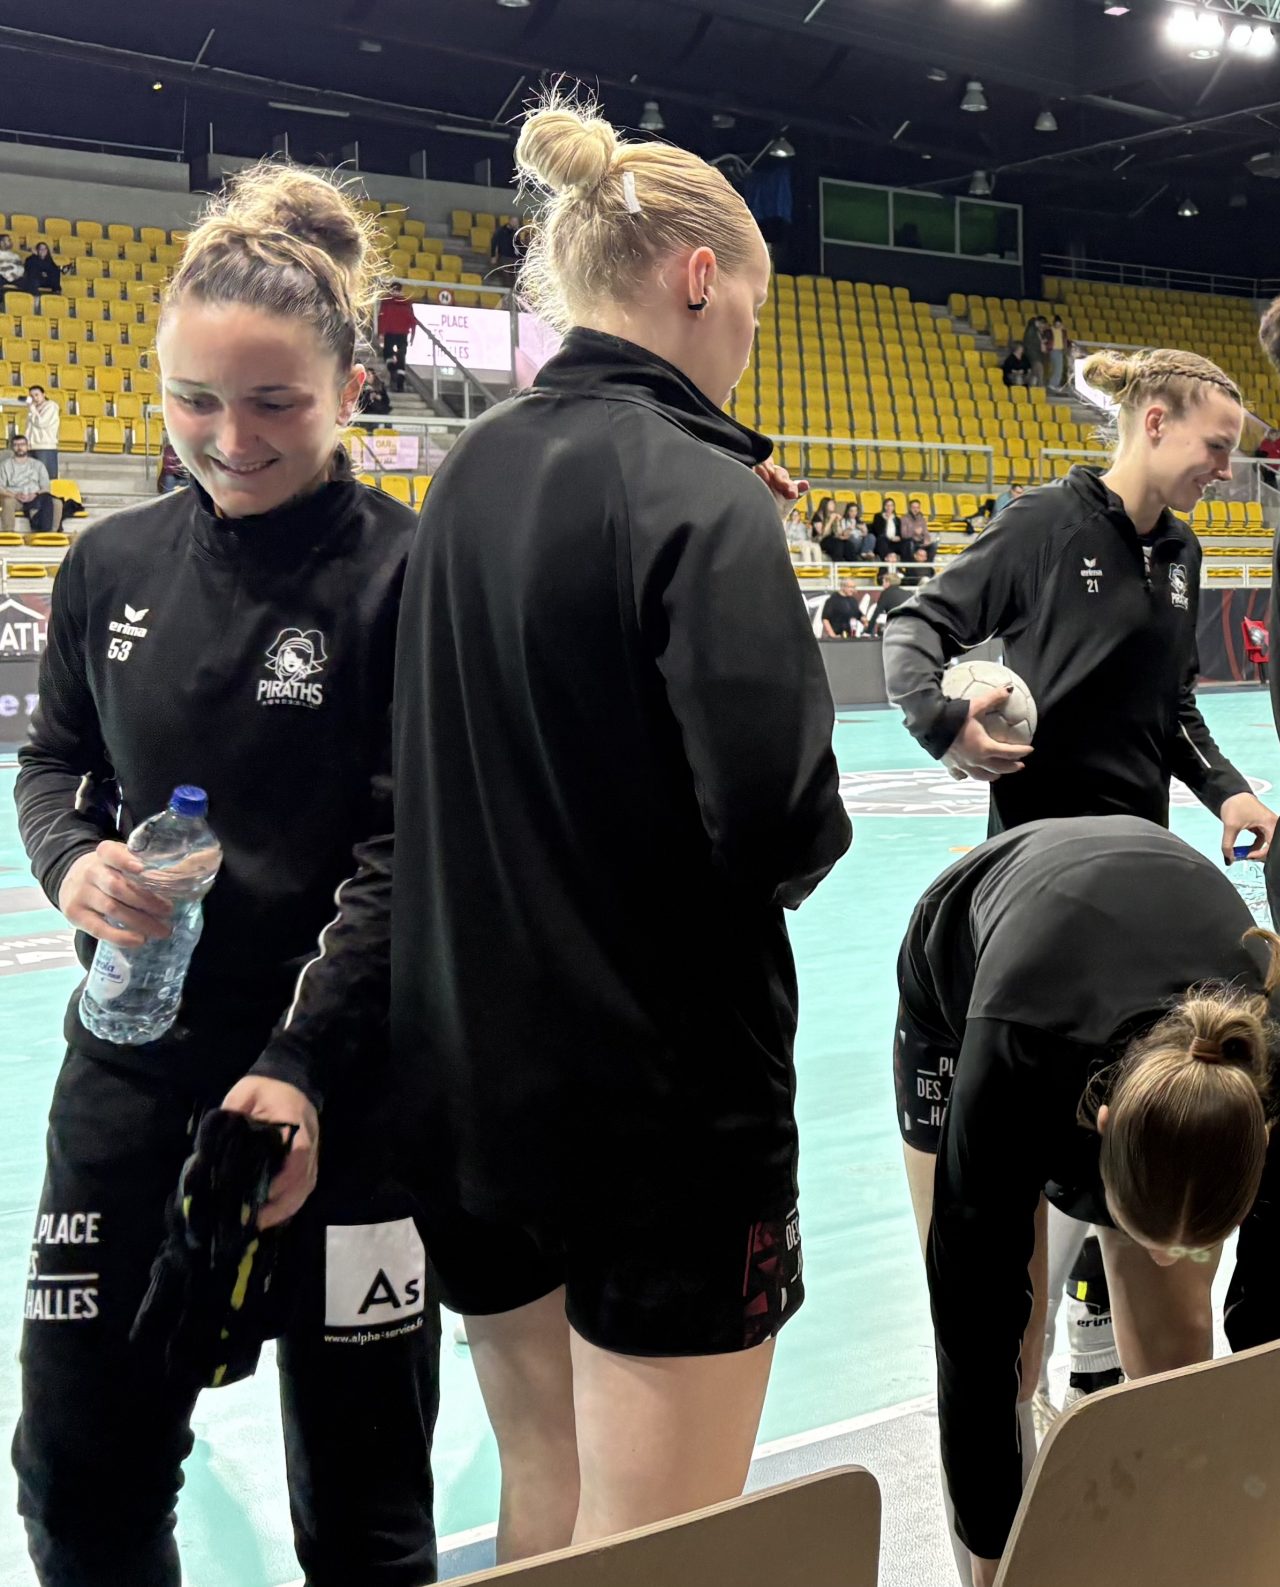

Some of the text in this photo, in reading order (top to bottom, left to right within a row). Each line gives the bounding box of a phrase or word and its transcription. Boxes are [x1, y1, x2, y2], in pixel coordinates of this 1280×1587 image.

[441, 314, 469, 328] PLACE
[1086, 578, 1099, 593] 21
[109, 621, 148, 638] erima
[108, 637, 133, 661] 53
[257, 679, 323, 705] PIRATHS
[916, 1077, 942, 1101] DES
[38, 1212, 101, 1245] PLACE
[25, 1286, 99, 1321] HALLES
[357, 1268, 419, 1315] As
[1077, 1316, 1113, 1328] erim
